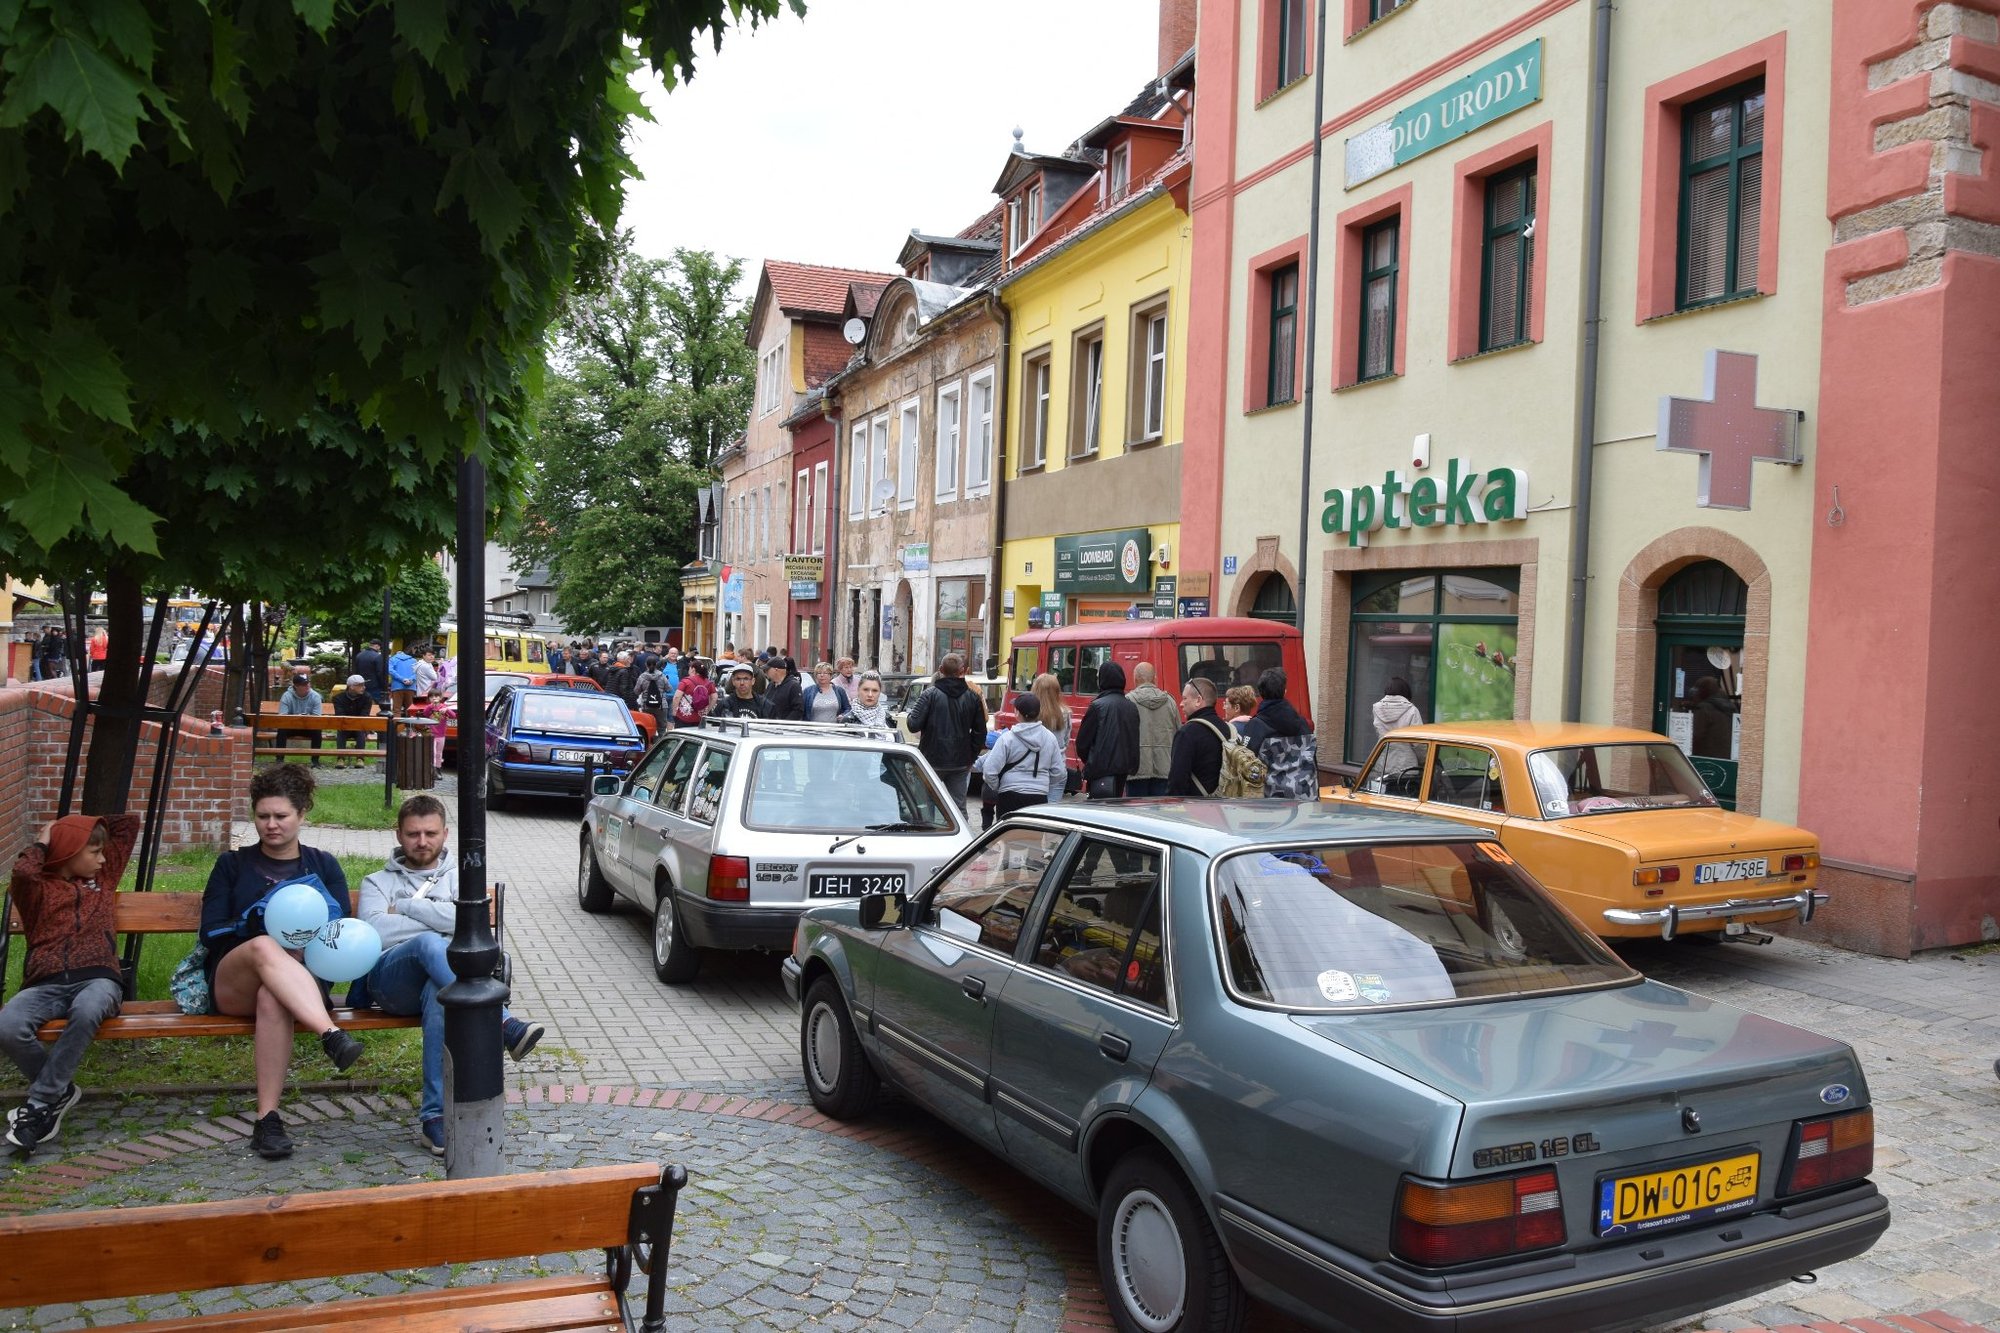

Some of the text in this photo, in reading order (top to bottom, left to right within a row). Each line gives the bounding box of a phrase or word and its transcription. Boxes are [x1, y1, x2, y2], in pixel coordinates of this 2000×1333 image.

[1440, 57, 1535, 129] URODY
[1321, 457, 1516, 547] apteka
[785, 556, 823, 564] KANTOR
[1080, 549, 1114, 564] LOOMBARD
[1225, 557, 1234, 568] 31
[1552, 800, 1564, 810] PL
[756, 863, 798, 872] ESCORT
[1703, 861, 1764, 881] DL 7758E
[814, 877, 851, 895] JEH
[861, 877, 903, 894] 3249
[1825, 1088, 1844, 1100] Ford
[1473, 1132, 1600, 1169] ORION 1.6 GL
[1619, 1166, 1722, 1221] DW 01G
[1601, 1209, 1612, 1221] PL
[1664, 1217, 1675, 1226] team
[1675, 1213, 1691, 1226] polska
